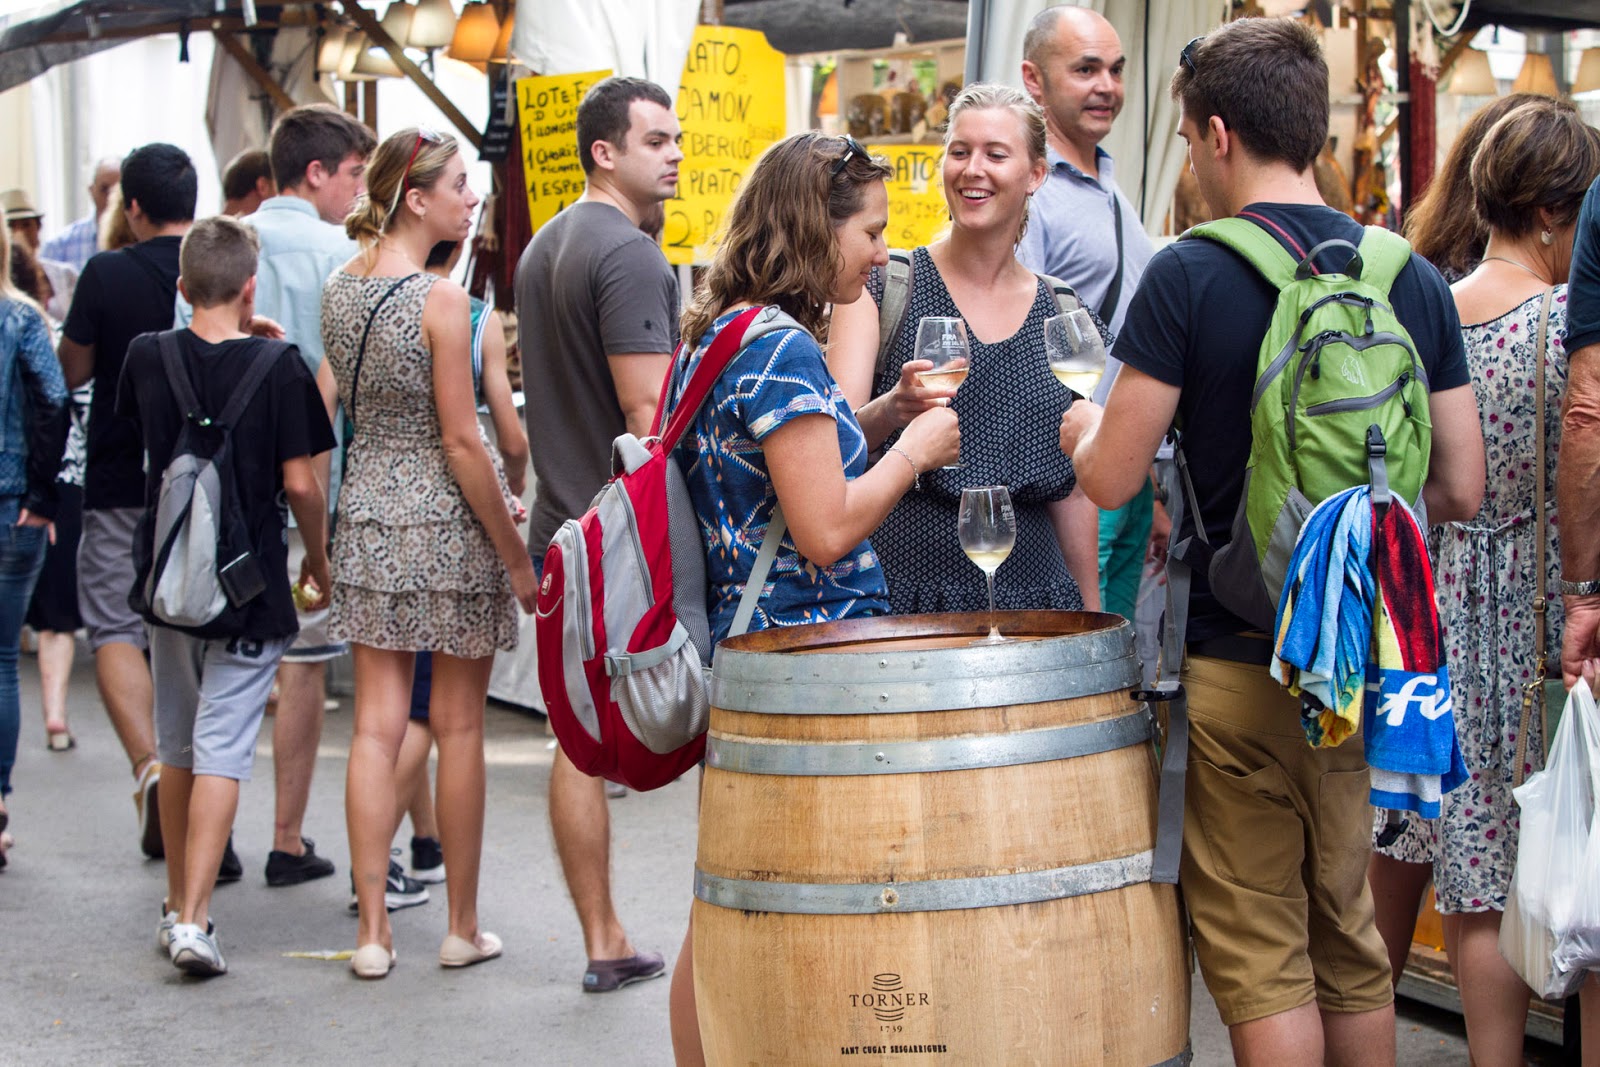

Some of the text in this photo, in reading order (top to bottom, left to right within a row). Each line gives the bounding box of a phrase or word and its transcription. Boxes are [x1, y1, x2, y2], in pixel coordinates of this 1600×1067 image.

[849, 993, 930, 1008] TORNER
[880, 1025, 903, 1033] 1739
[841, 1044, 947, 1055] SANT CUGAT SESGARRIGUES
